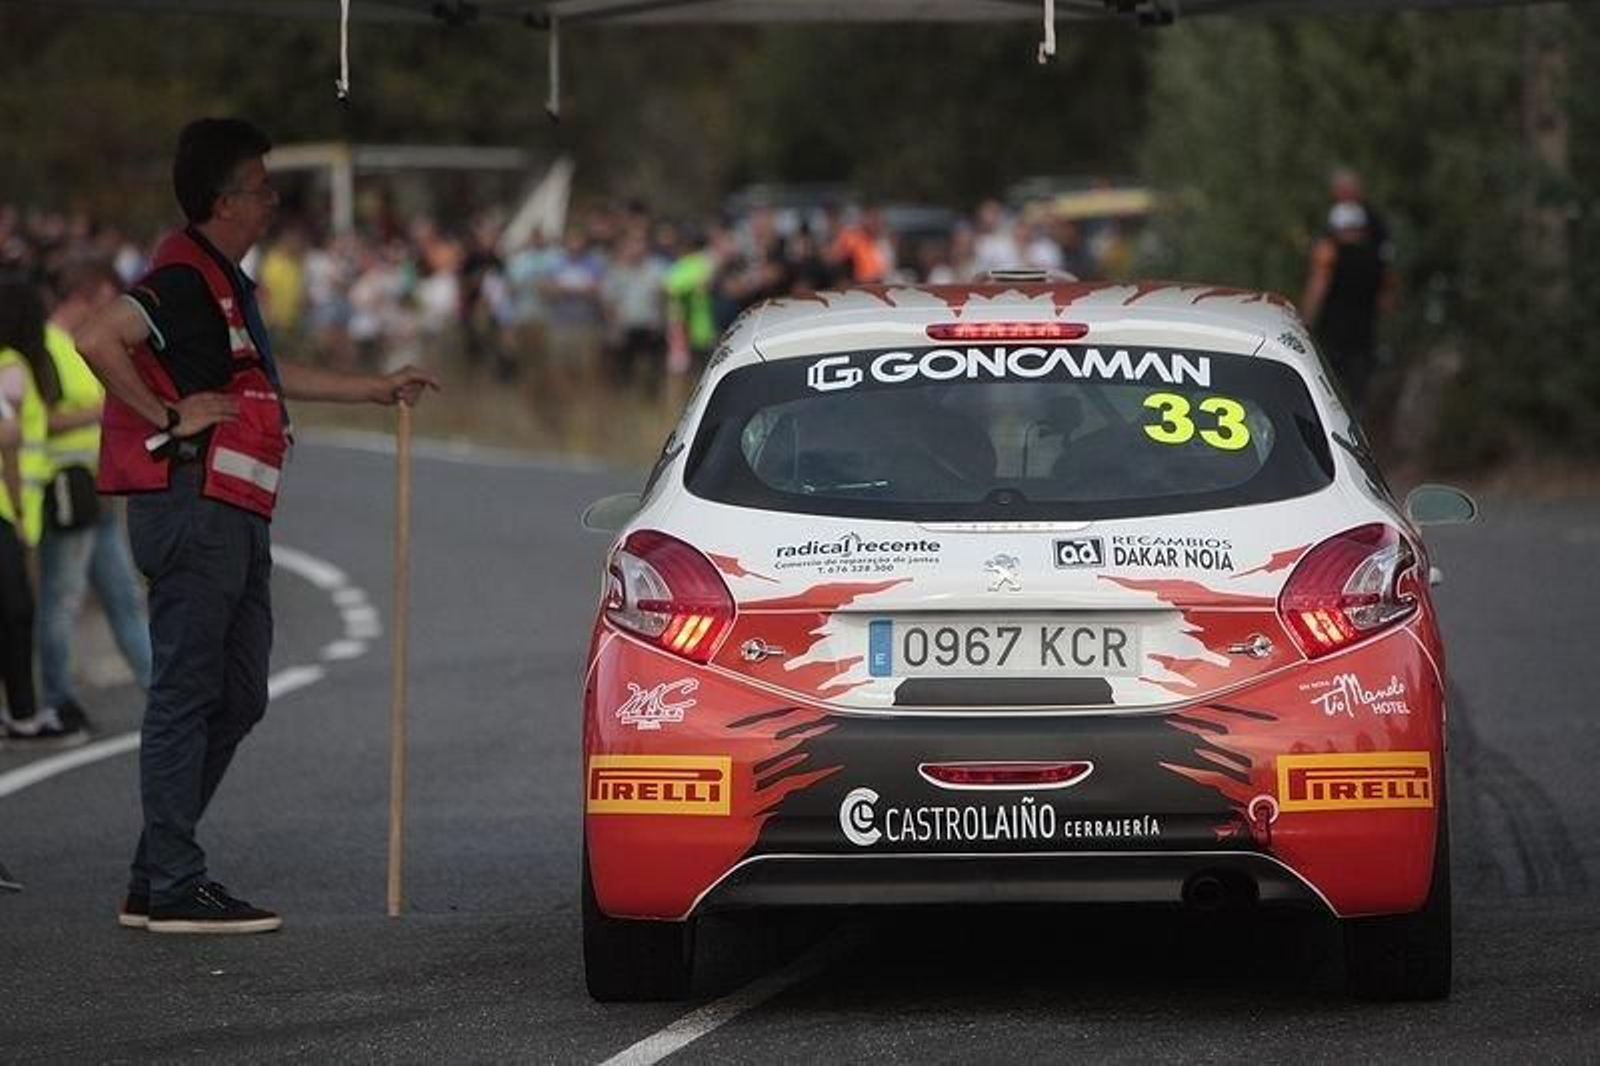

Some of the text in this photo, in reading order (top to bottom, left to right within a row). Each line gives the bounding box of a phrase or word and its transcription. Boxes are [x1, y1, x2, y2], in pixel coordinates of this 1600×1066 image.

[870, 347, 1212, 387] GONCAMAN
[1142, 392, 1250, 451] 33
[776, 539, 942, 557] radical recente
[1058, 540, 1100, 565] ad
[1112, 535, 1233, 549] RECAMBIOS
[1114, 547, 1235, 572] DAKAR NOIA
[875, 626, 1128, 668] E 0967 KCR
[1371, 700, 1411, 715] HOTEL
[590, 767, 724, 803] PIRELLI
[1287, 766, 1430, 802] PIRELLI
[885, 796, 1056, 842] CASTROLAIÑO
[1064, 815, 1161, 838] CERRAJERÍA
